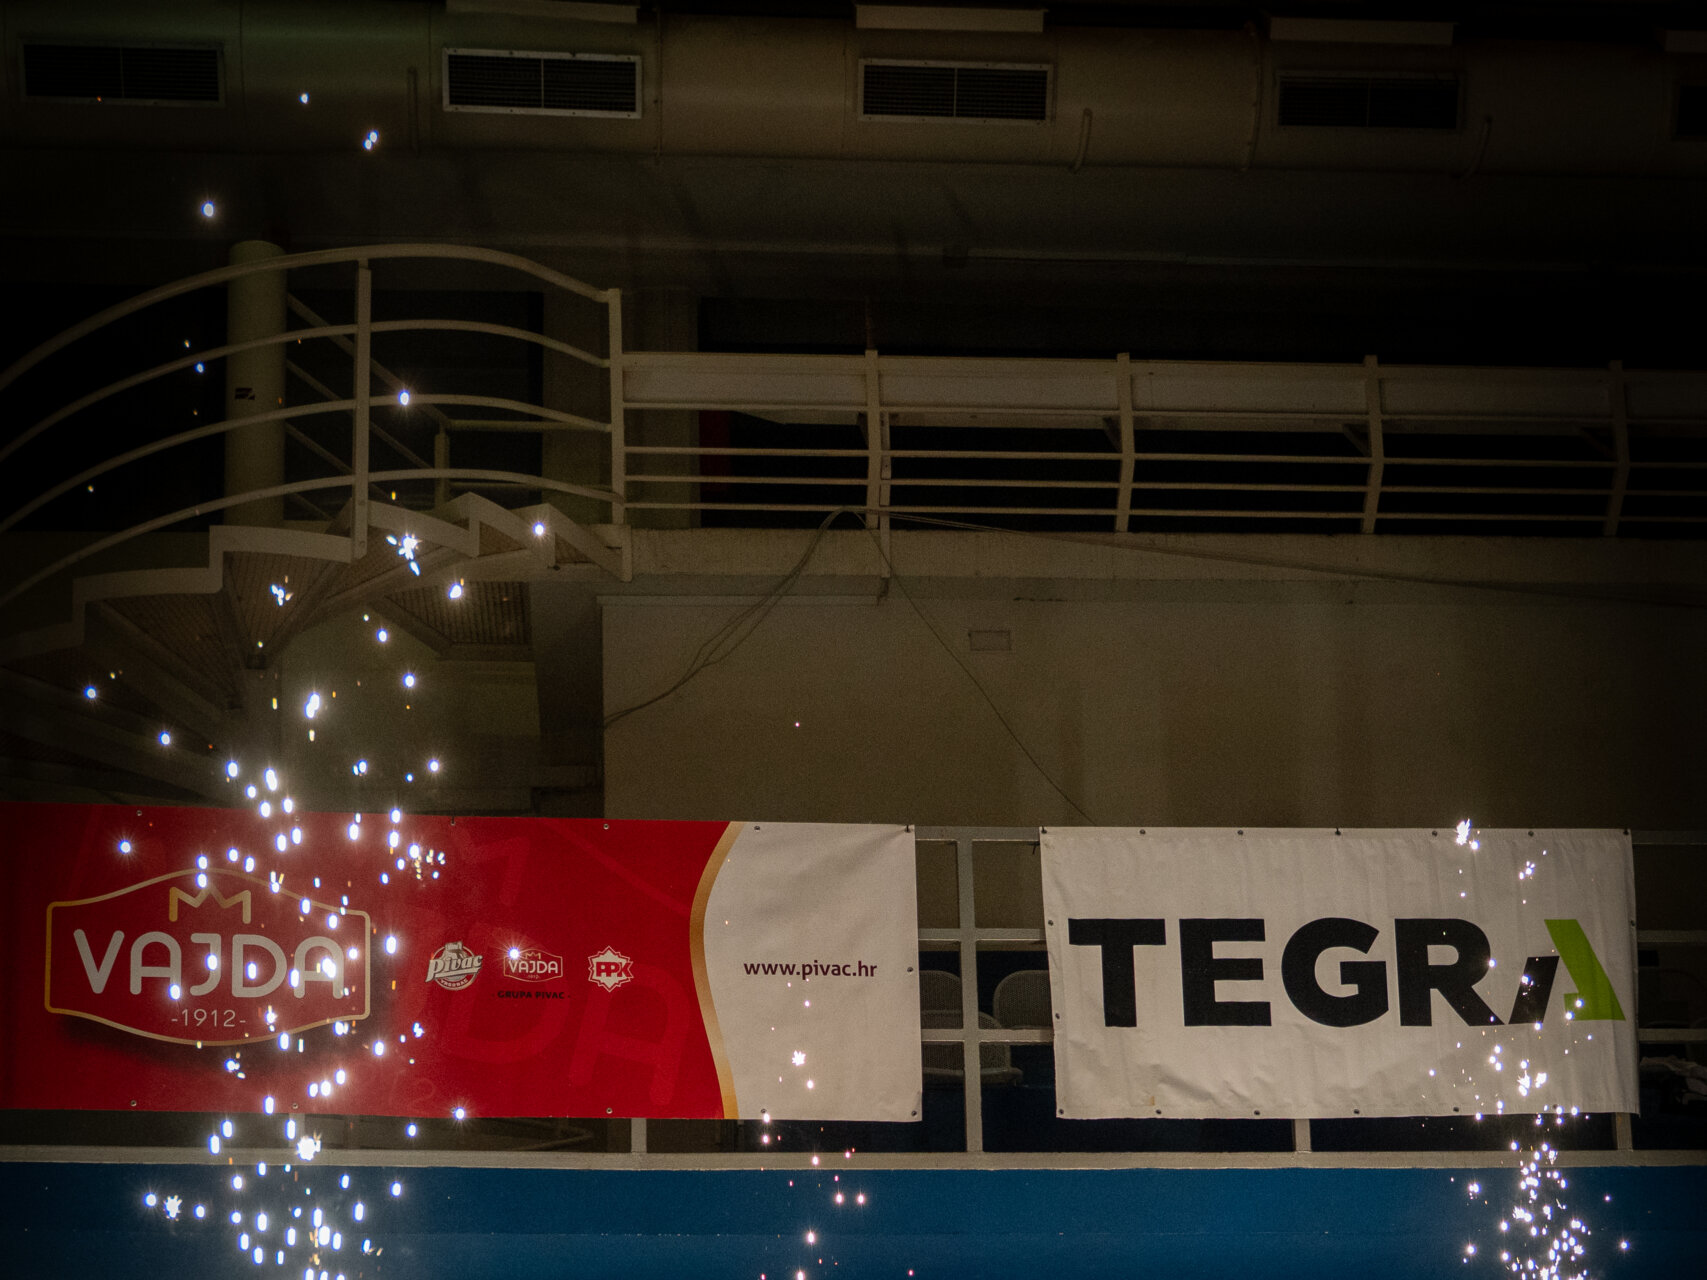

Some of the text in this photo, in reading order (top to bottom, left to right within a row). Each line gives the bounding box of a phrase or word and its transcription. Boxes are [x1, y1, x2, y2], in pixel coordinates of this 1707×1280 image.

[73, 928, 345, 999] VAJDA
[508, 960, 559, 974] VAJDA
[595, 961, 631, 978] PPK
[743, 960, 877, 981] www.pivac.hr
[1067, 916, 1627, 1027] TEGRA
[497, 990, 565, 999] GRUPA PIVAC
